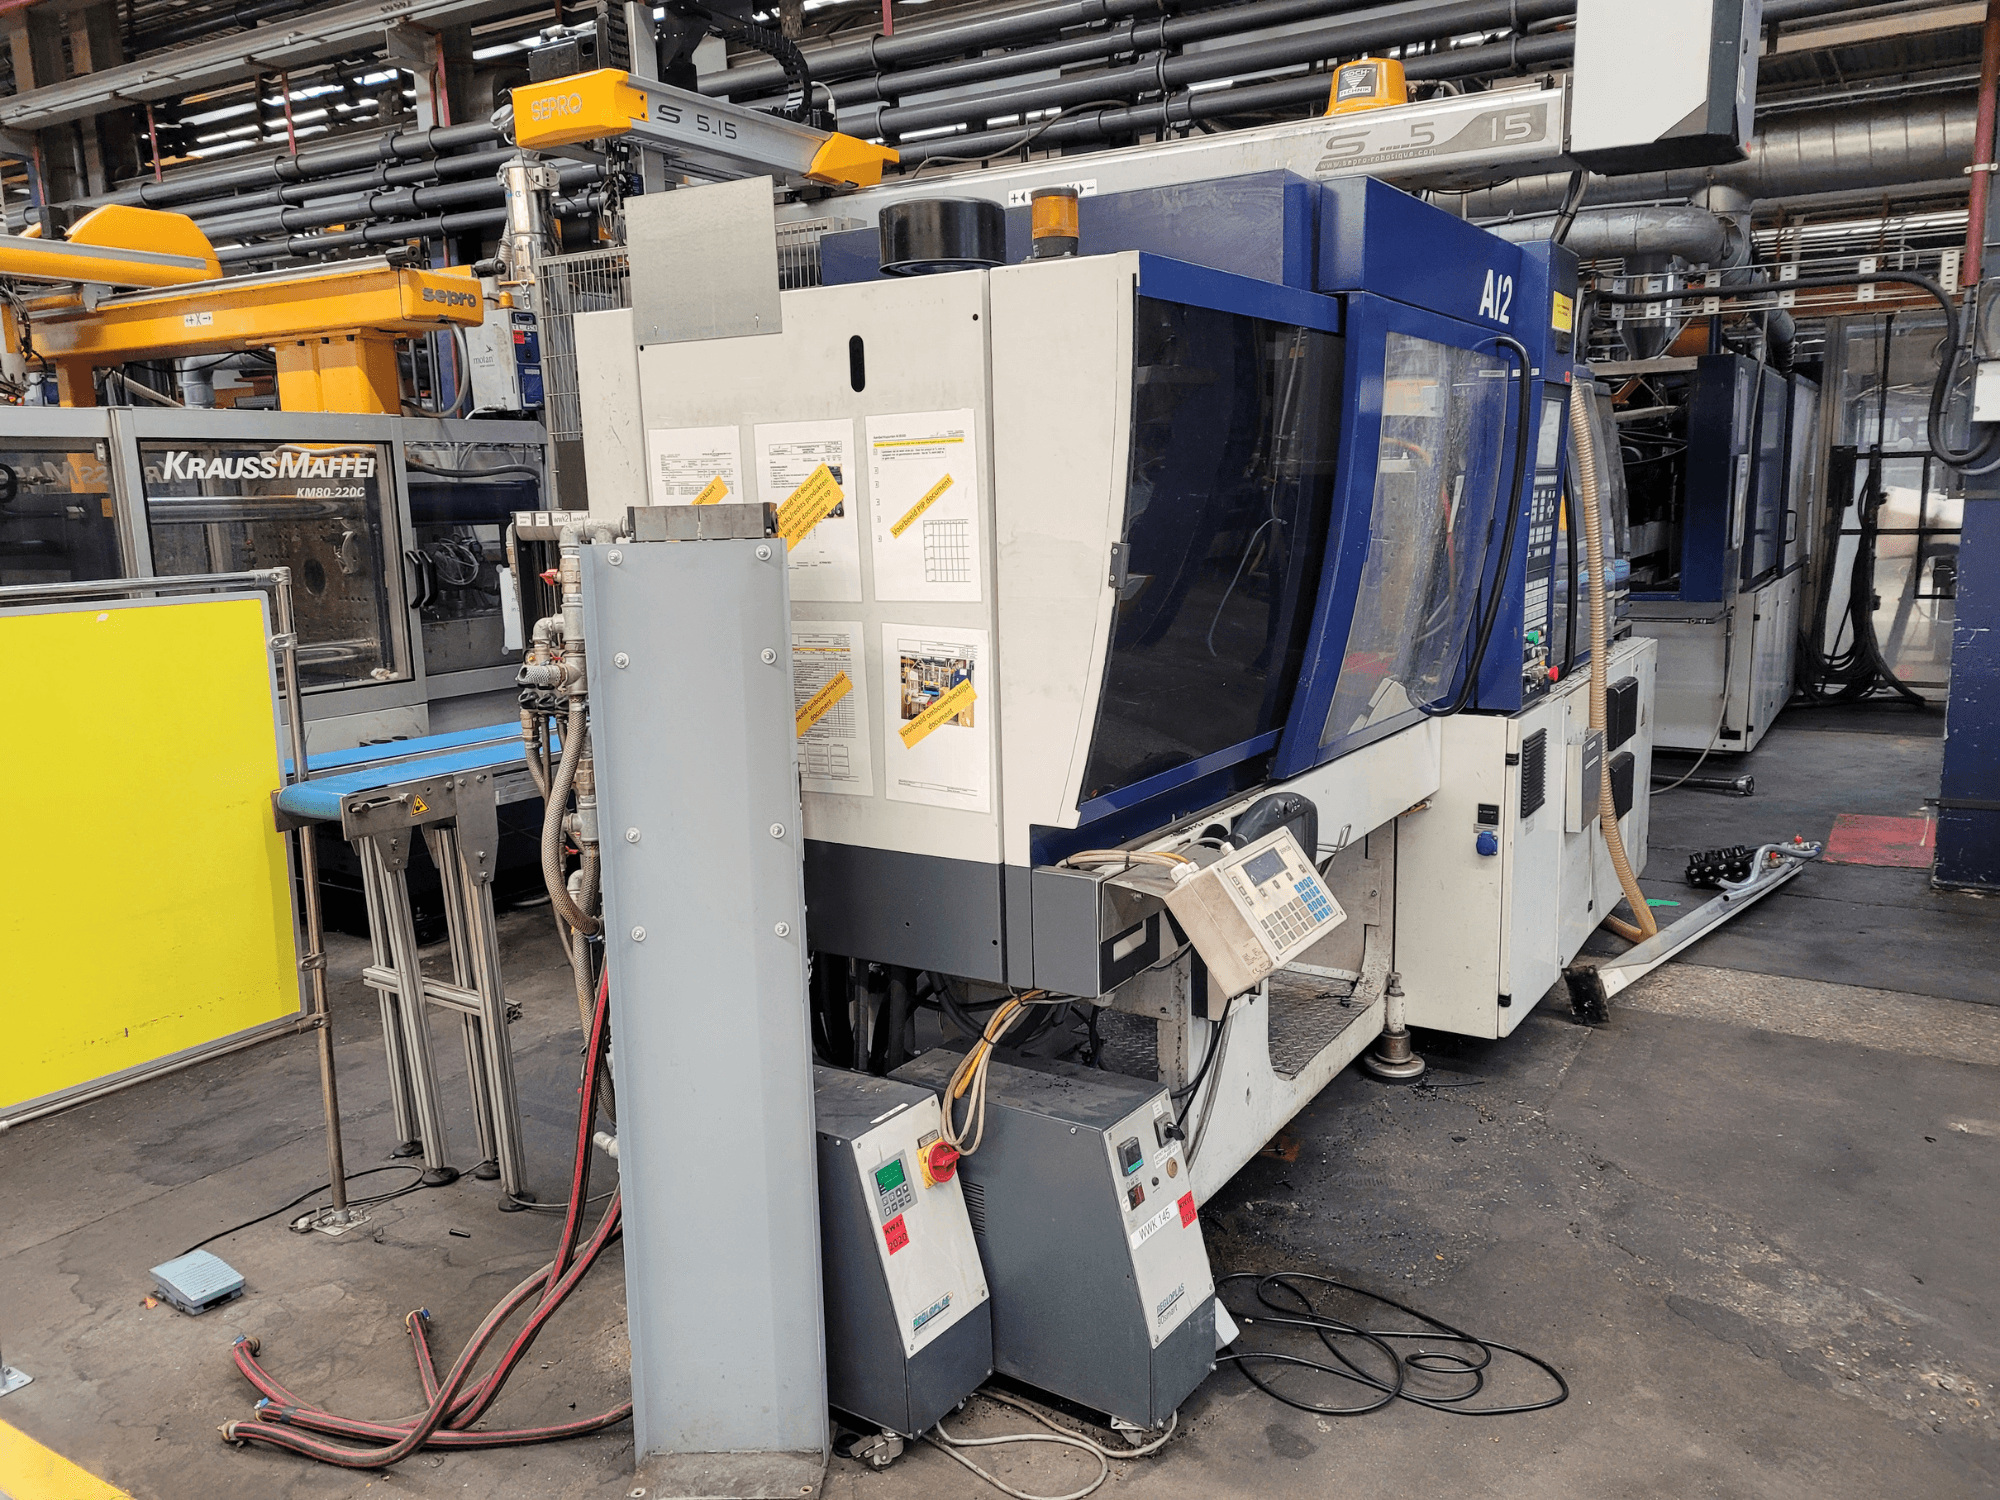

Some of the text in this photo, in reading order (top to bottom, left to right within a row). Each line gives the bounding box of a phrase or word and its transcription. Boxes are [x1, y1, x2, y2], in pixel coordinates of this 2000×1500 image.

[1341, 69, 1370, 78] KOCH
[1340, 87, 1370, 96] TECHNIK
[531, 92, 583, 122] SEPRO
[656, 104, 683, 124] S
[1491, 112, 1532, 141] 15
[1319, 147, 1438, 170] www.sepro-robotique.com
[421, 287, 477, 308] sepro
[1478, 268, 1513, 325] A12
[163, 451, 375, 480] KRAUSSMAFFEI
[296, 487, 365, 498] KM80-220C
[800, 469, 825, 495] document
[791, 517, 802, 531] naar
[801, 495, 825, 520] document
[823, 489, 831, 498] op
[891, 508, 919, 536] Voorbeeld
[925, 477, 952, 505] document
[807, 673, 846, 712] ombouwchecklijst
[810, 699, 833, 722] document
[900, 682, 971, 738] Voorbeeld ombouwchecklijst
[928, 708, 954, 730] document
[1138, 1207, 1171, 1241] WWK 145
[889, 1233, 907, 1251] 2020
[1156, 1283, 1185, 1314] REGLOPLAS
